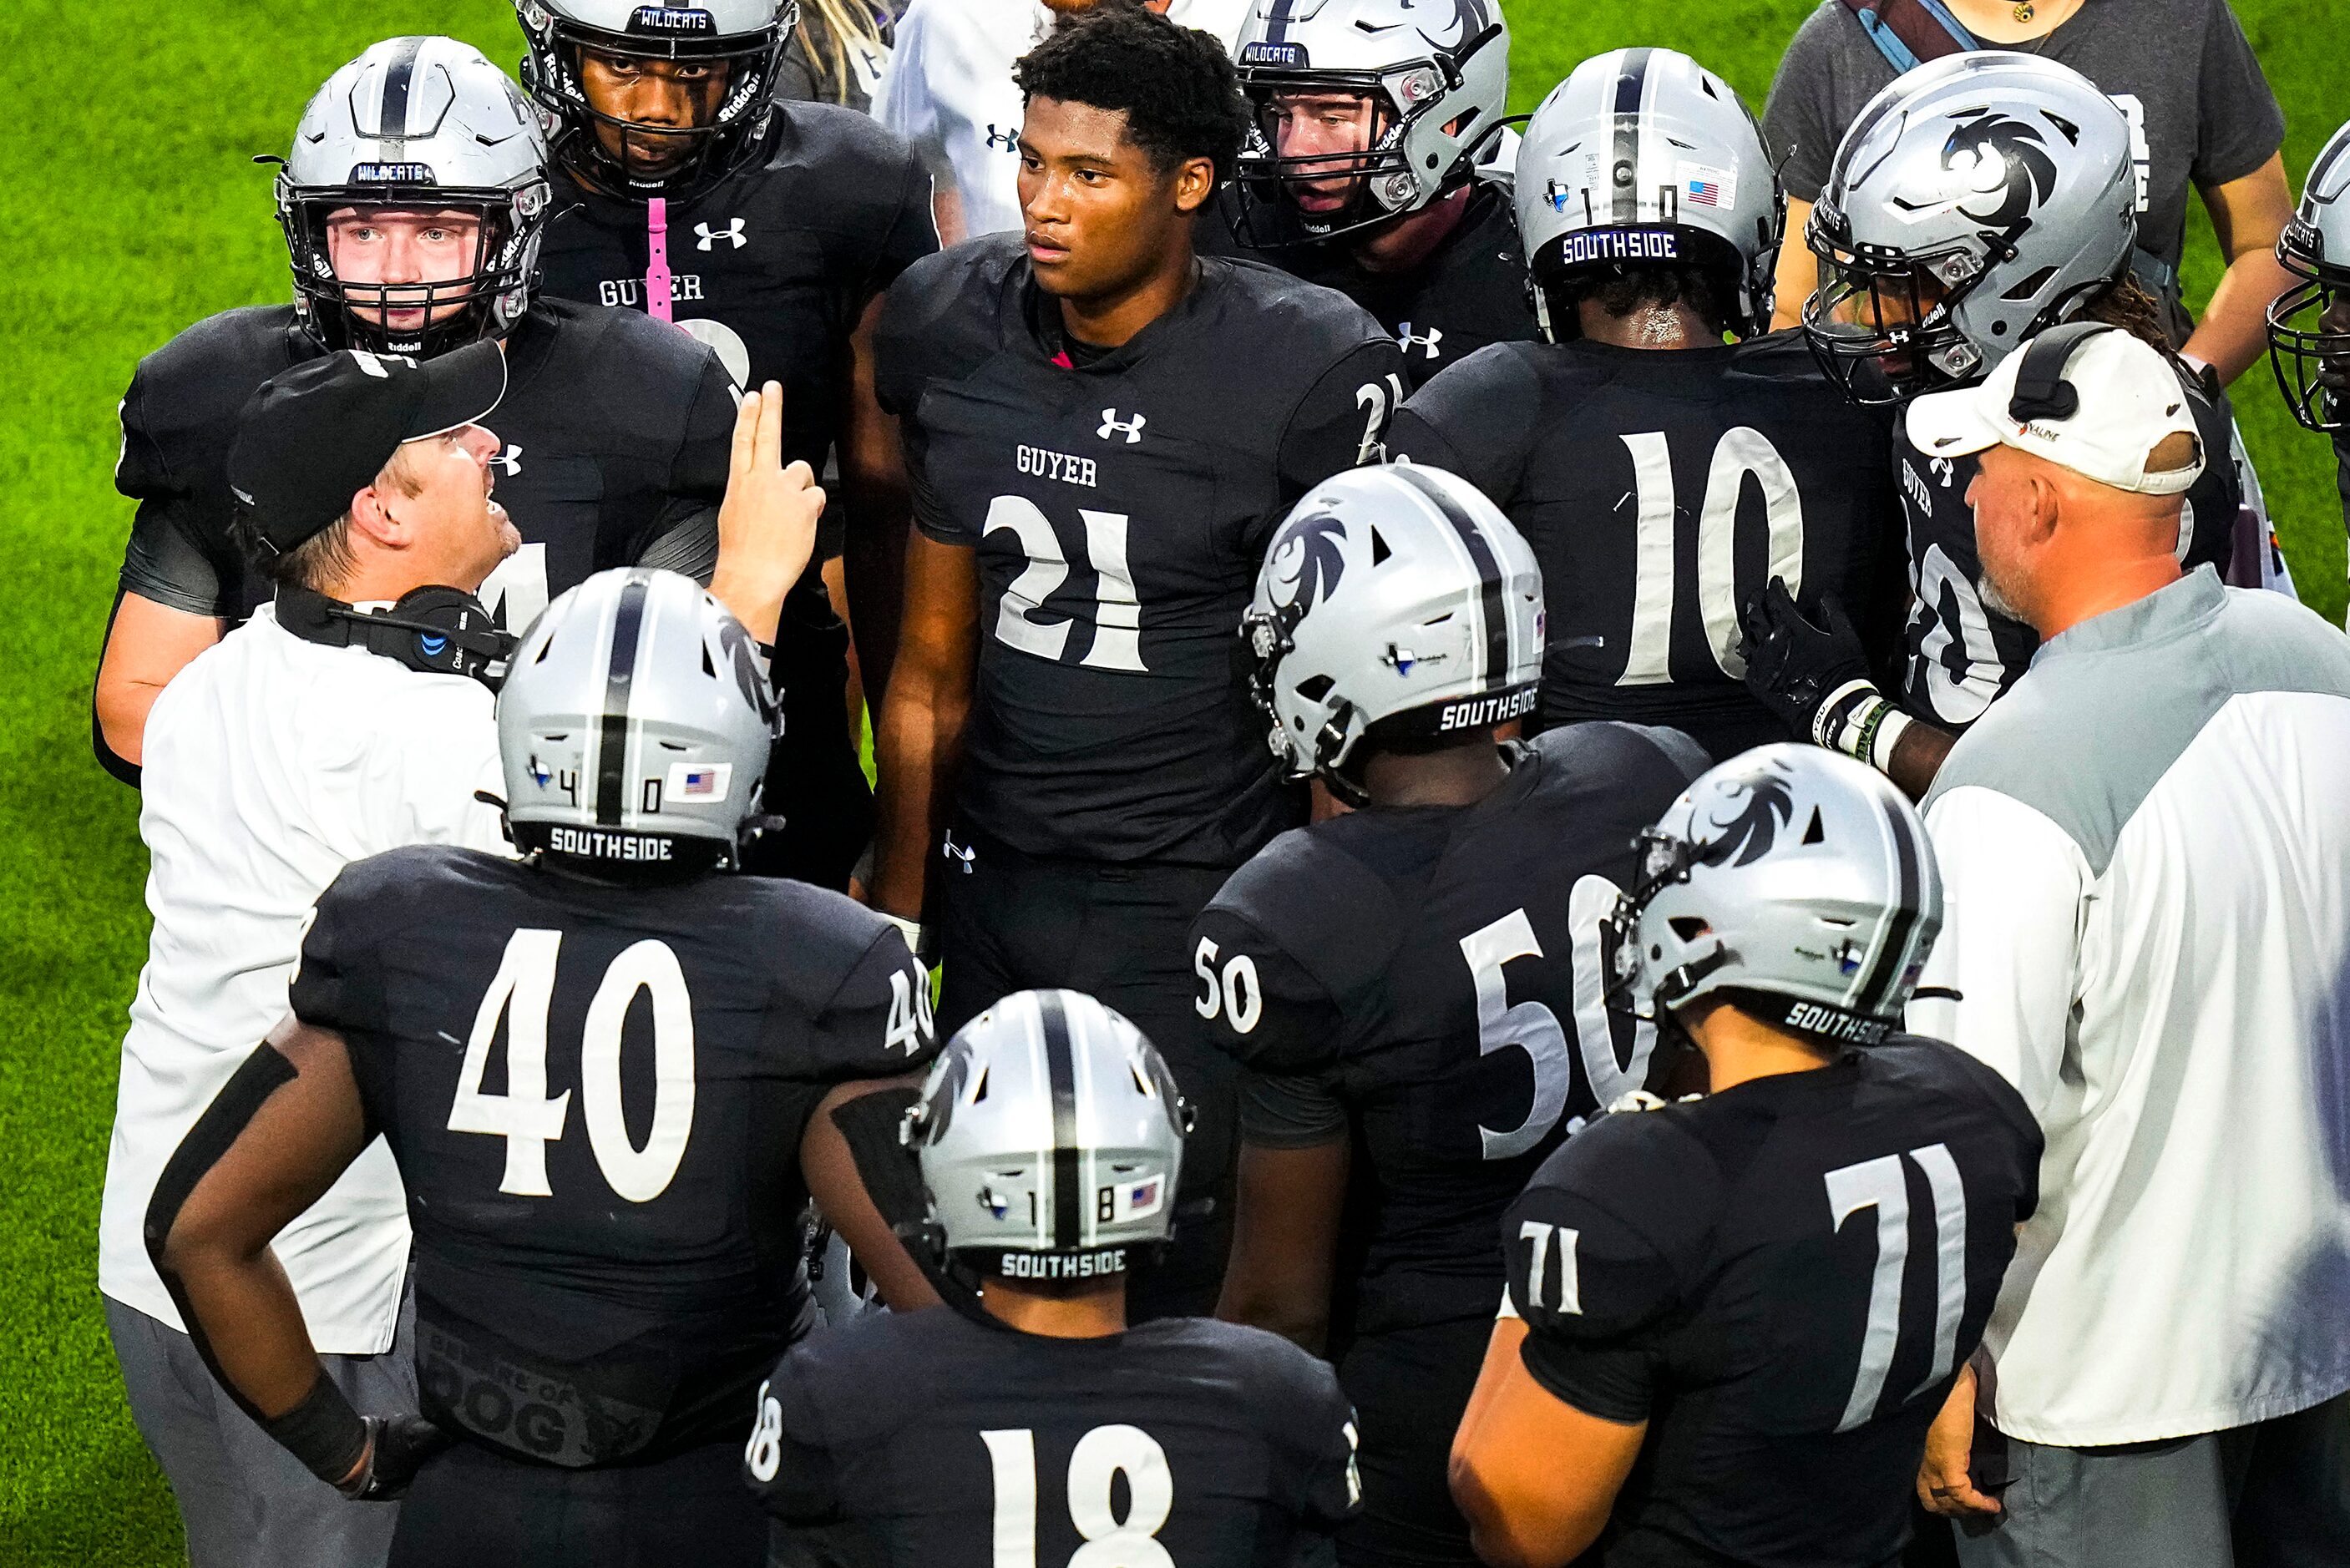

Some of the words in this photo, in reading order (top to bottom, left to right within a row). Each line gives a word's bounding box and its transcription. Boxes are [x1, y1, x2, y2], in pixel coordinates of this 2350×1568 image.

[641, 9, 707, 29] WILDCATS
[1245, 46, 1295, 63] WILDCATS
[357, 164, 423, 181] WILDCATS
[1562, 232, 1678, 265] SOUTHSIDE
[599, 274, 706, 307] GUER
[387, 341, 422, 352] Riddell
[1015, 444, 1097, 488] GUYER
[1613, 426, 1804, 687] 10
[982, 494, 1150, 673] 21
[1440, 687, 1538, 731] SOUTHSIDE
[550, 827, 673, 862] SOUTHSIDE
[1194, 935, 1263, 1034] 50
[884, 956, 934, 1058] 40
[1459, 873, 1659, 1161] 50
[447, 927, 696, 1203] 40
[1000, 1249, 1127, 1278] SOUTHSIDE
[1519, 1220, 1584, 1316] 71
[1824, 1142, 1967, 1434] 71
[979, 1423, 1176, 1568] 18
